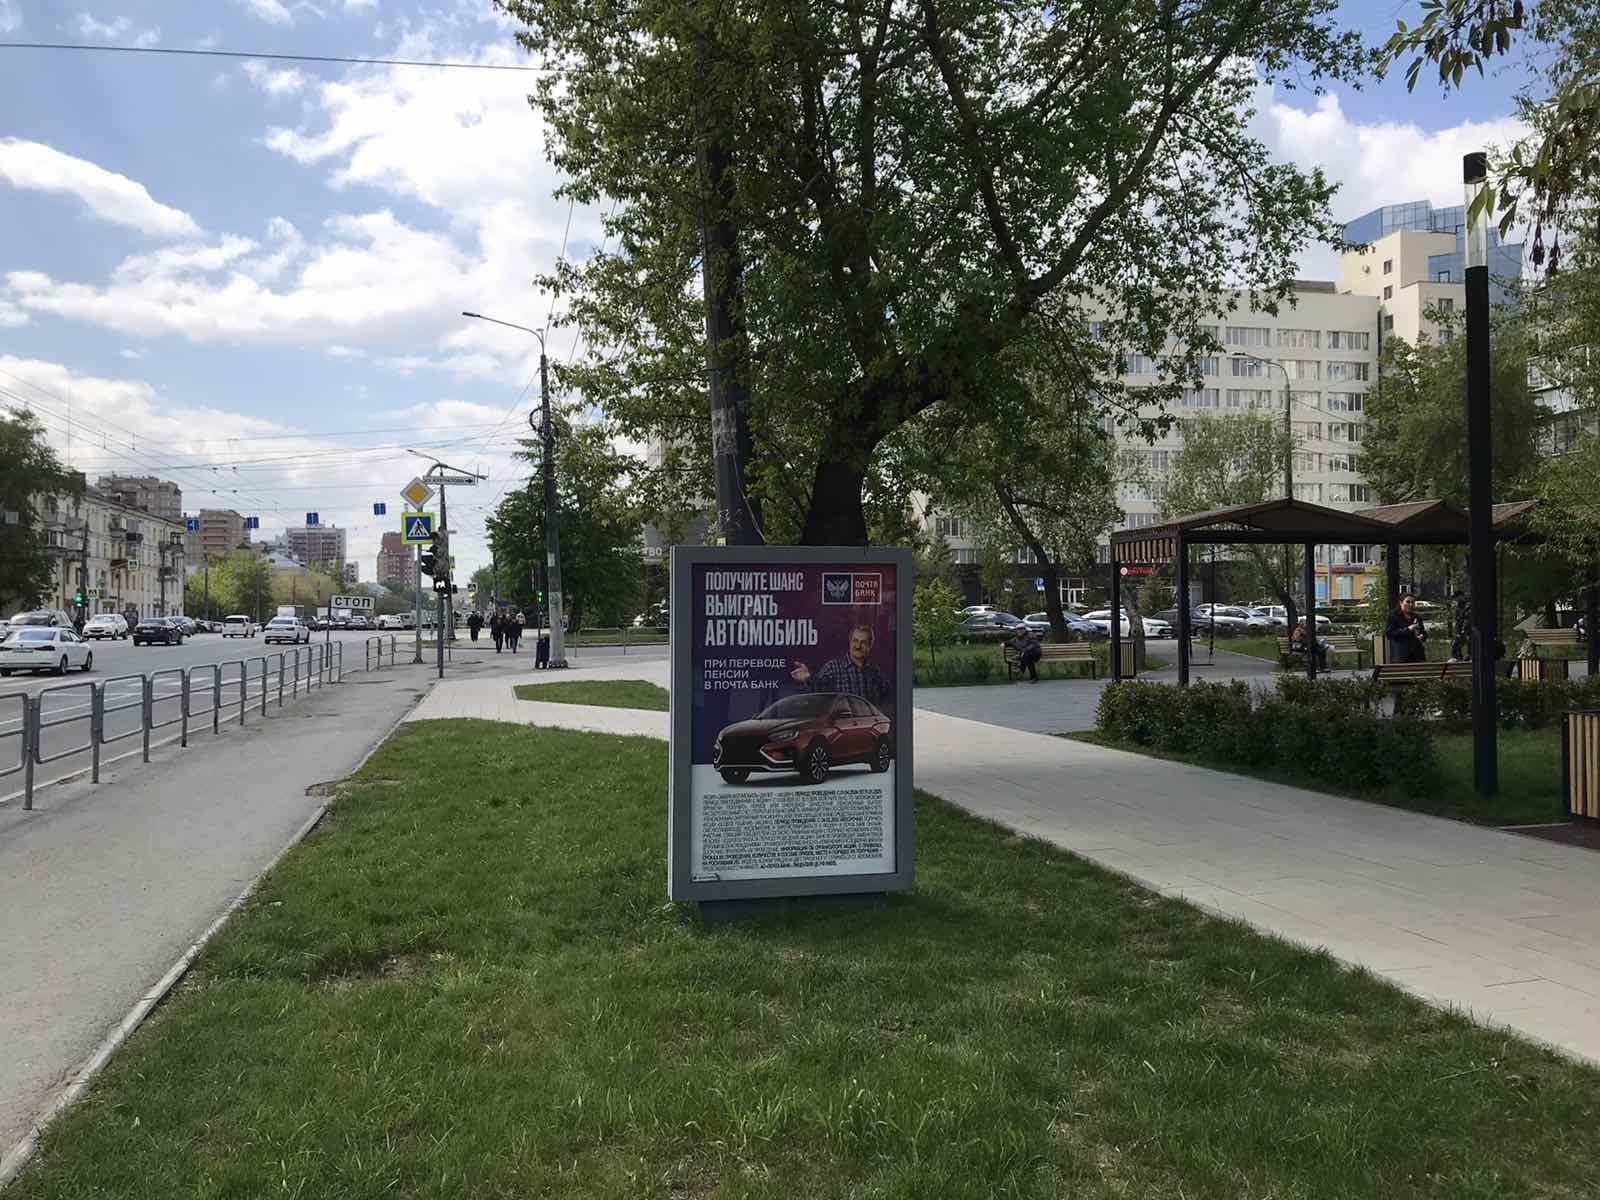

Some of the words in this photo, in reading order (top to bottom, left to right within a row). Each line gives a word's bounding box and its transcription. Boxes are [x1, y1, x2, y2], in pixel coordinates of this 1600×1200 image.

[705, 571, 768, 591] ПОЛУЧИТЕ
[769, 571, 804, 591] ШАНС
[855, 589, 876, 597] БАНК
[335, 597, 370, 607] СТОП
[705, 594, 778, 616] ВЫИГРАТЬ
[705, 619, 818, 646] АВТОМОБИЛЬ
[704, 659, 727, 669] ПРИ
[729, 658, 786, 668] ПЕРЕВОДЕ
[704, 669, 750, 679] ПЕНСИИ
[704, 681, 712, 690] В
[715, 680, 748, 689] ПОЧТА
[750, 680, 779, 689] БАНК
